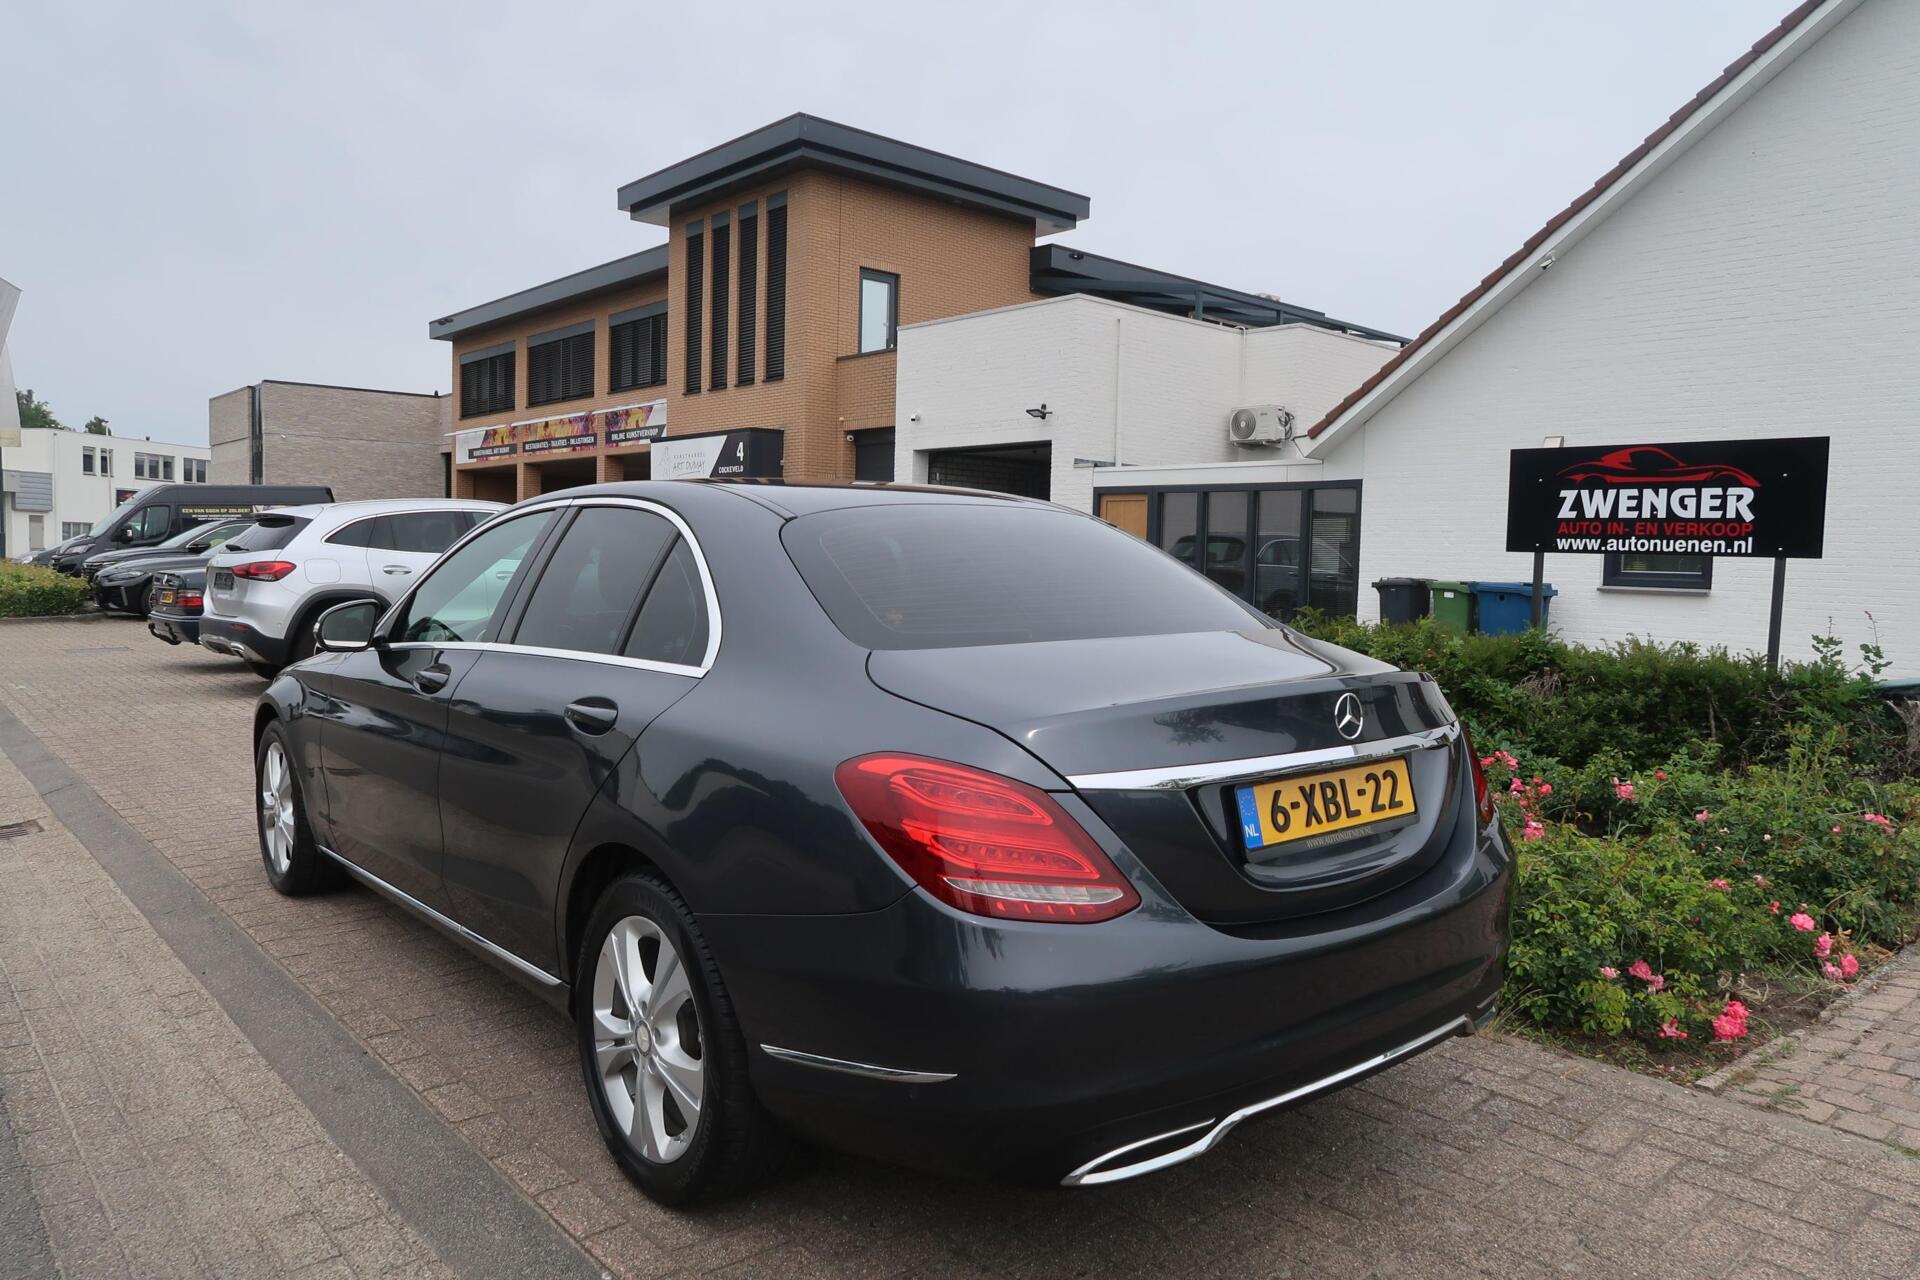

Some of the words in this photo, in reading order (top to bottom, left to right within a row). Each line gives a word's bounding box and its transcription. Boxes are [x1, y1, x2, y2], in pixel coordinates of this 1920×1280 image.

[736, 441, 744, 462] 4
[1556, 487, 1756, 522] ZWENGER
[1558, 522, 1602, 535] AUTO
[1607, 522, 1630, 536] IN-
[1636, 523, 1658, 536] EN
[1664, 522, 1753, 538] VERKOOP
[1556, 536, 1753, 554] www.autonuenen.nl
[1271, 770, 1404, 833] 6-XBL-22
[1244, 824, 1260, 838] NL
